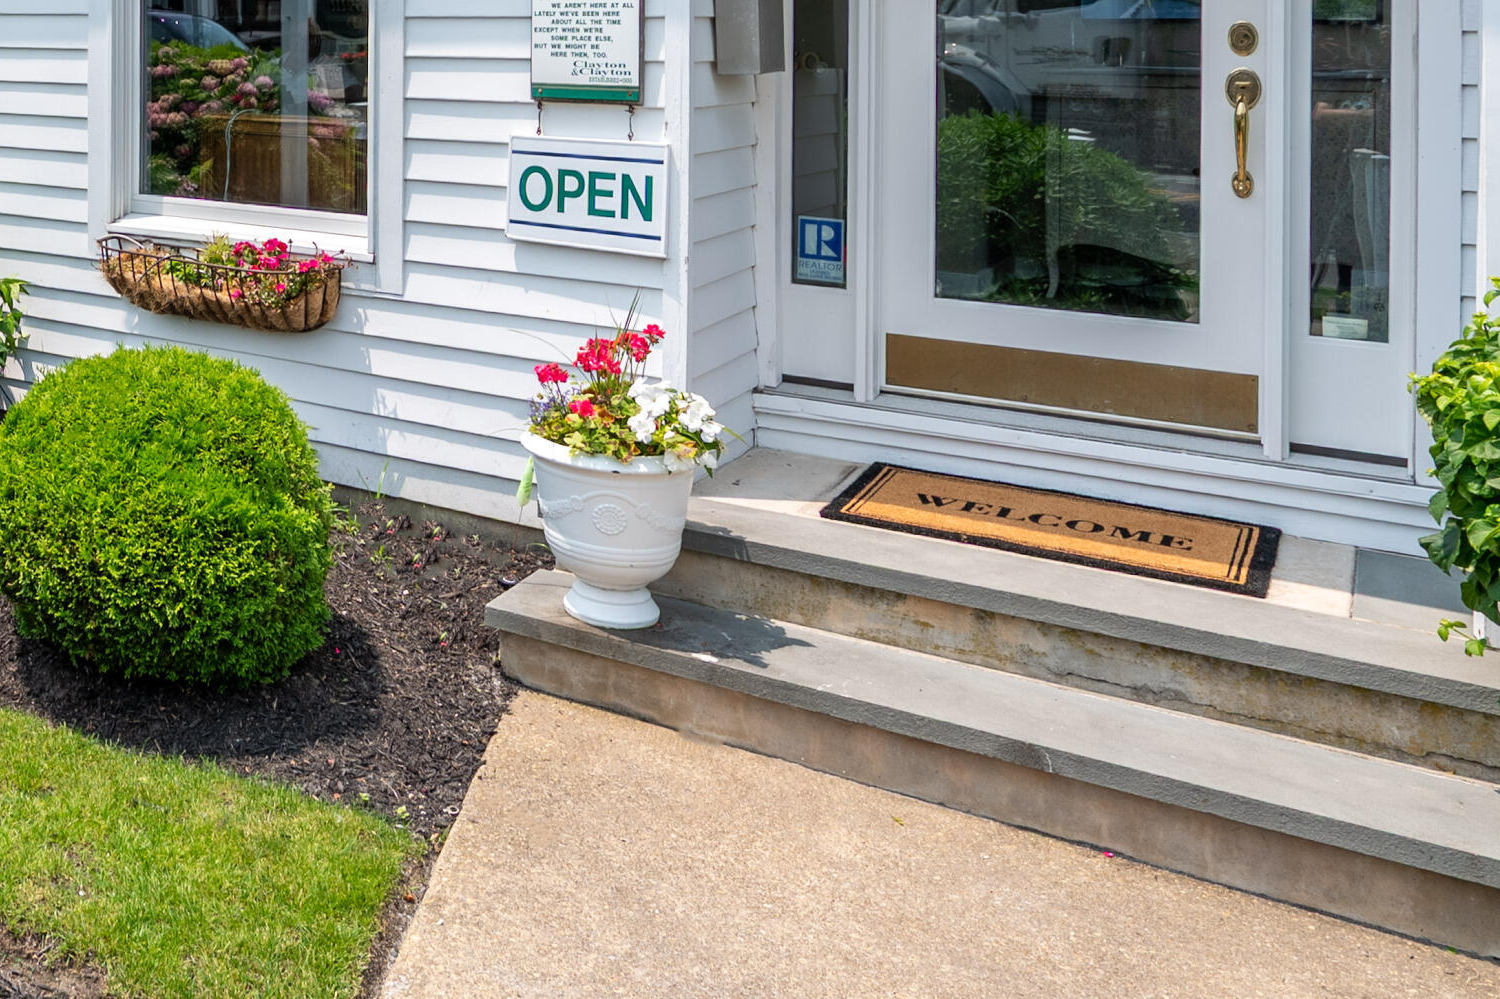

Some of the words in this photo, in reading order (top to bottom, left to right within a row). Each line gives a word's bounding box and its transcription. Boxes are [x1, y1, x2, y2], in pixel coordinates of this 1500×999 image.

[573, 60, 626, 68] Clayton
[519, 165, 653, 222] OPEN
[916, 492, 1193, 551] WELCOME
